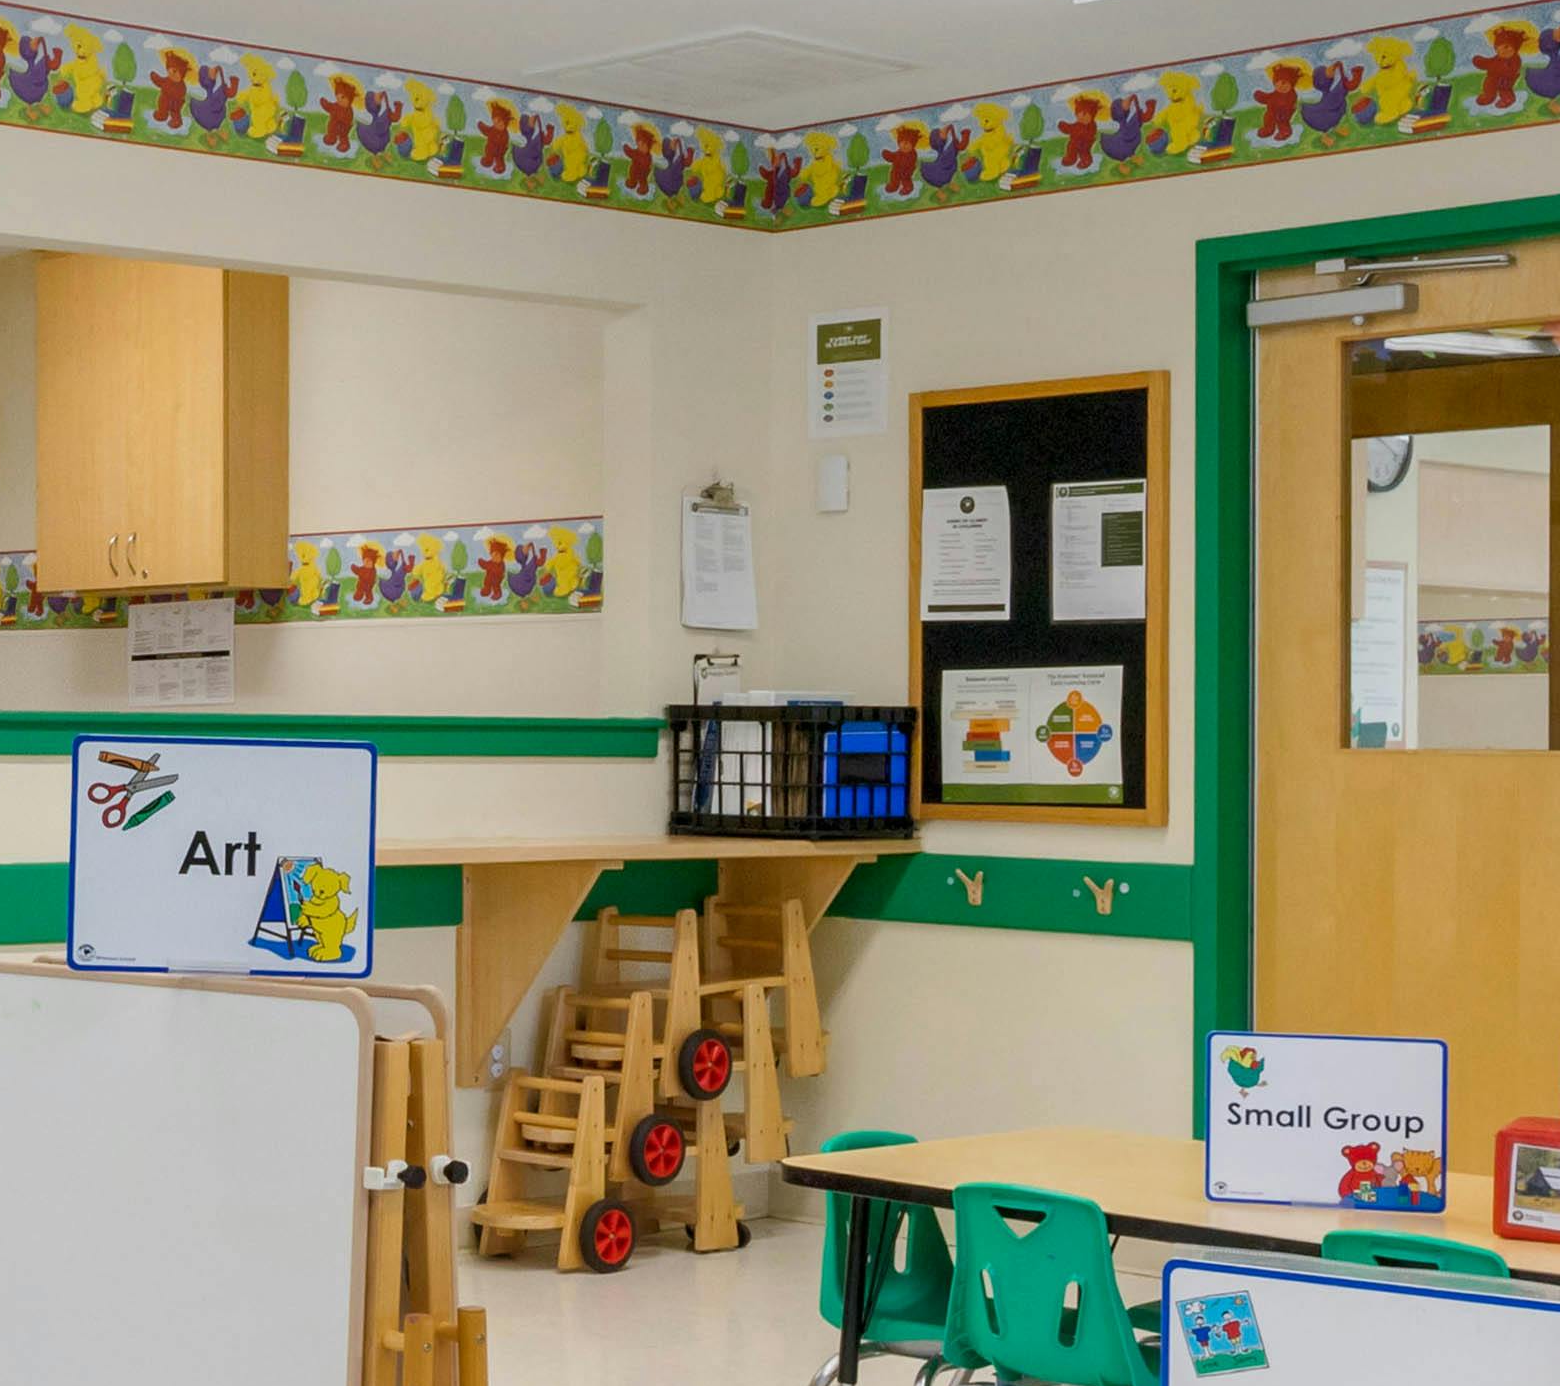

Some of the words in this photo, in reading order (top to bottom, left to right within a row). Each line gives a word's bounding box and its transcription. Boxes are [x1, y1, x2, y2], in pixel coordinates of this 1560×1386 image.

[177, 830, 262, 877] Art
[1226, 1102, 1312, 1128] Small
[1323, 1106, 1425, 1139] Group
